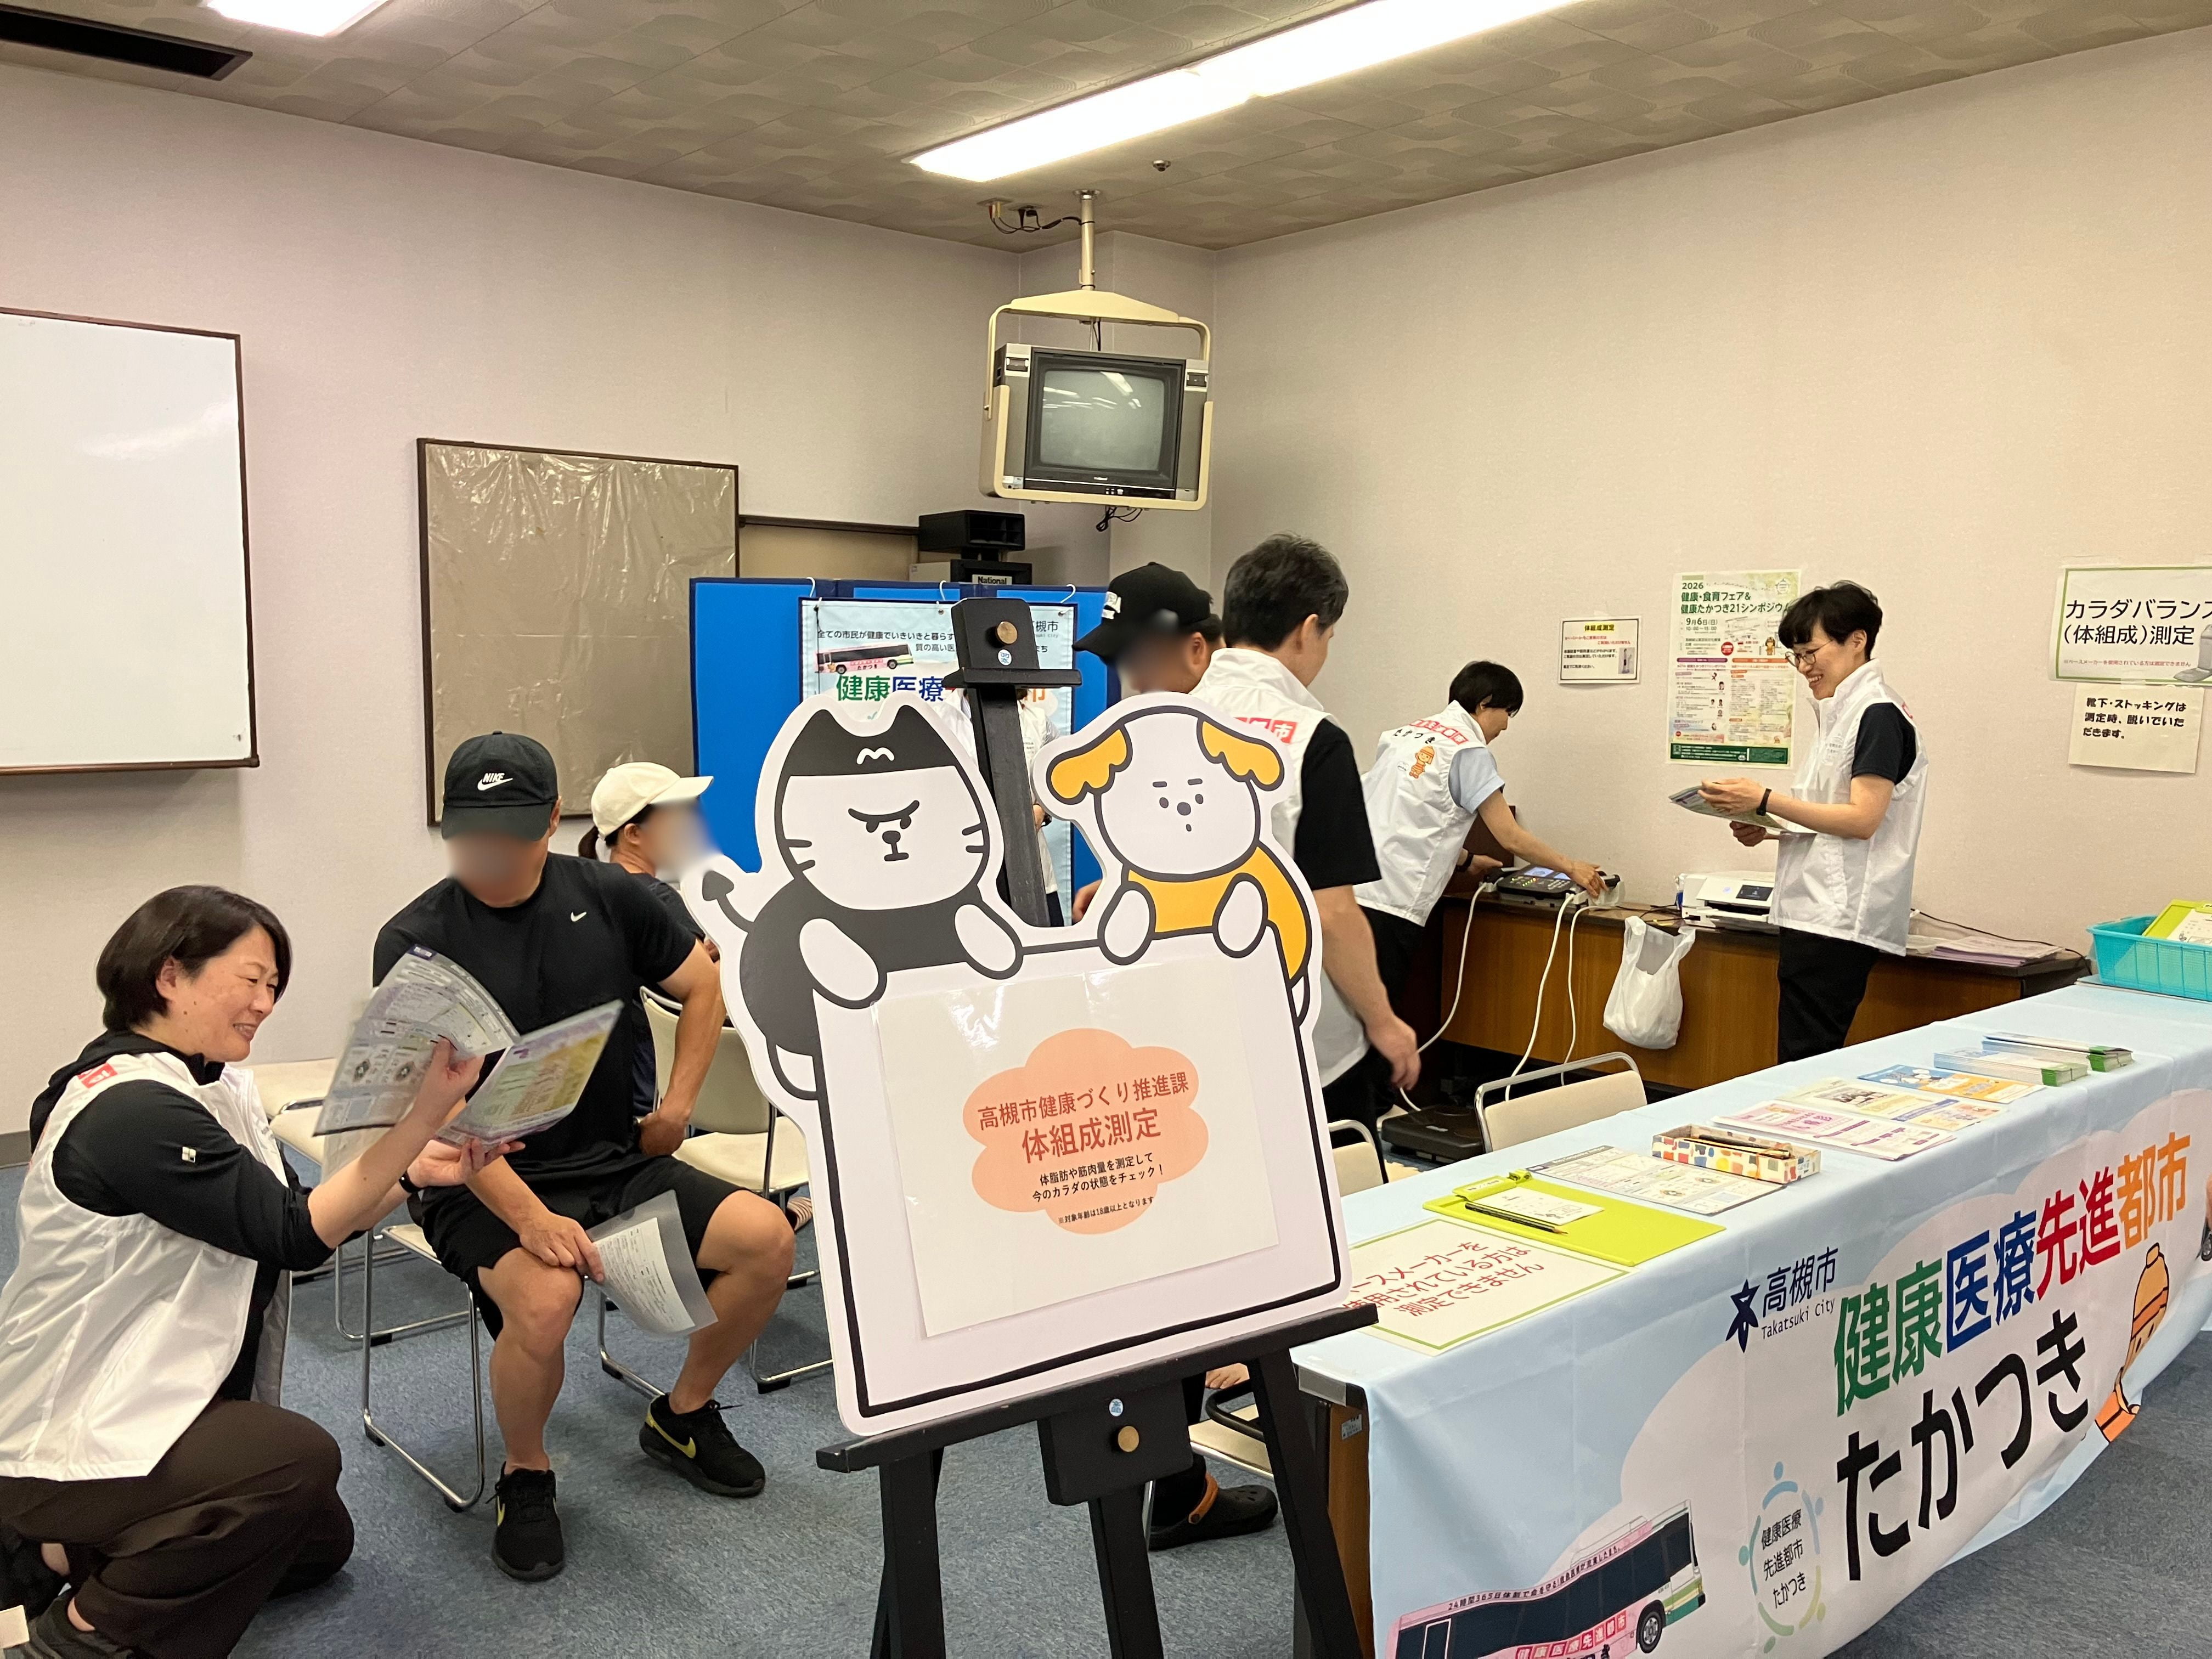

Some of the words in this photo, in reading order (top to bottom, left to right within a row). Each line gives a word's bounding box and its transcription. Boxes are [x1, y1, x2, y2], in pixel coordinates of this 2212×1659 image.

[978, 576, 1007, 584] National
[1033, 620, 1059, 632] 槻市
[1680, 602, 1790, 614] 健康たかつき21シンポジウ
[2064, 624, 2194, 645] (体組成)測定
[2086, 697, 2187, 712] 靴下・ストッキングは
[2083, 727, 2125, 739] だきます。
[482, 772, 505, 783] NIKE
[978, 1071, 1189, 1131] 高槻市健康づくり推進課
[1022, 1107, 1161, 1164] 体組成測定
[1040, 1152, 1153, 1186] 体脂肪や筋肉量を測定して
[1350, 1242, 1488, 1293] ースメーカーを
[1762, 1246, 1838, 1318] 高槻市
[1833, 1131, 2191, 1417] 健康医療先進都市
[1393, 1263, 1545, 1317] 測定できません
[1762, 1306, 1809, 1340] Takatsuki
[1815, 1298, 1835, 1317] City
[1836, 1309, 2089, 1581] たかつき
[1761, 1509, 1802, 1550] 健康医療
[1763, 1538, 1804, 1581] 先進都市
[1773, 1571, 1807, 1610] たかつき
